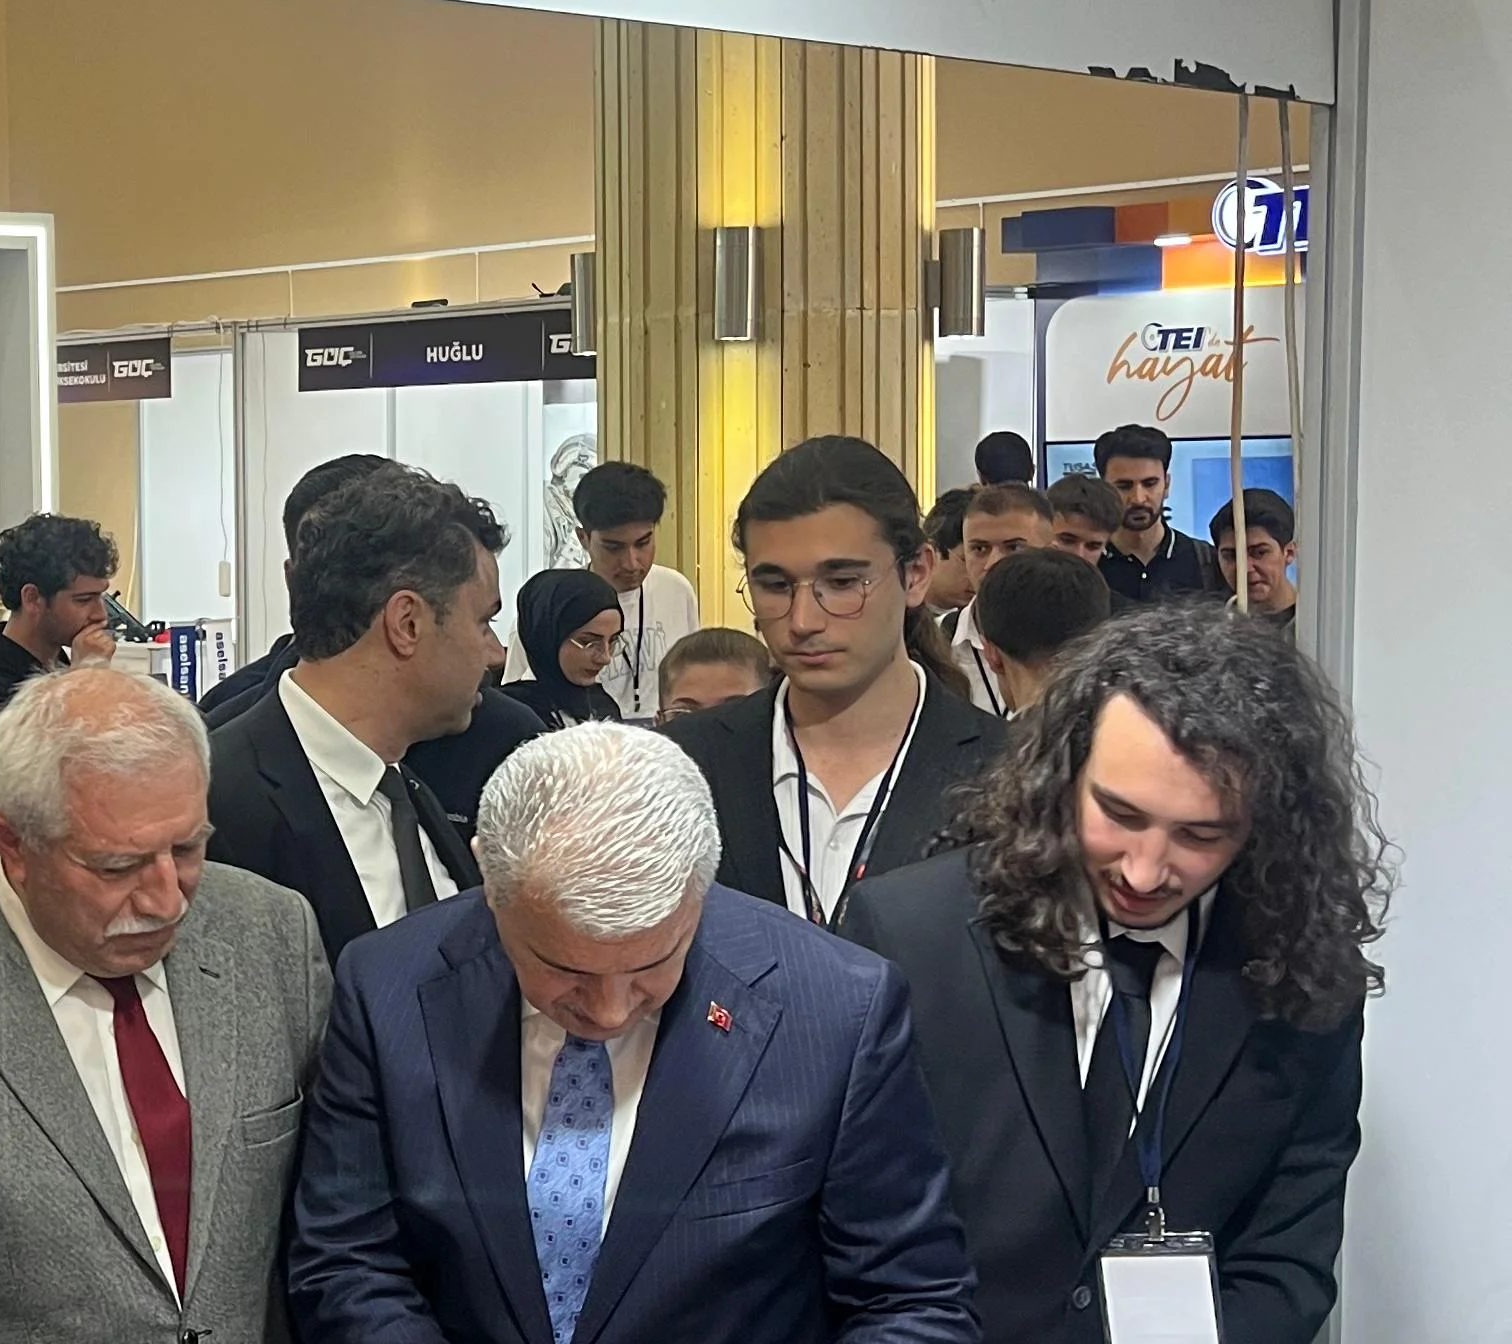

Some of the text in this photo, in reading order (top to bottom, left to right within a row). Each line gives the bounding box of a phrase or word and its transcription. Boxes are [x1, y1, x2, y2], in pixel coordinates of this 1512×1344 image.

[1157, 326, 1206, 350] TEI
[426, 341, 483, 363] HUĞLU
[1106, 325, 1280, 421] hayat
